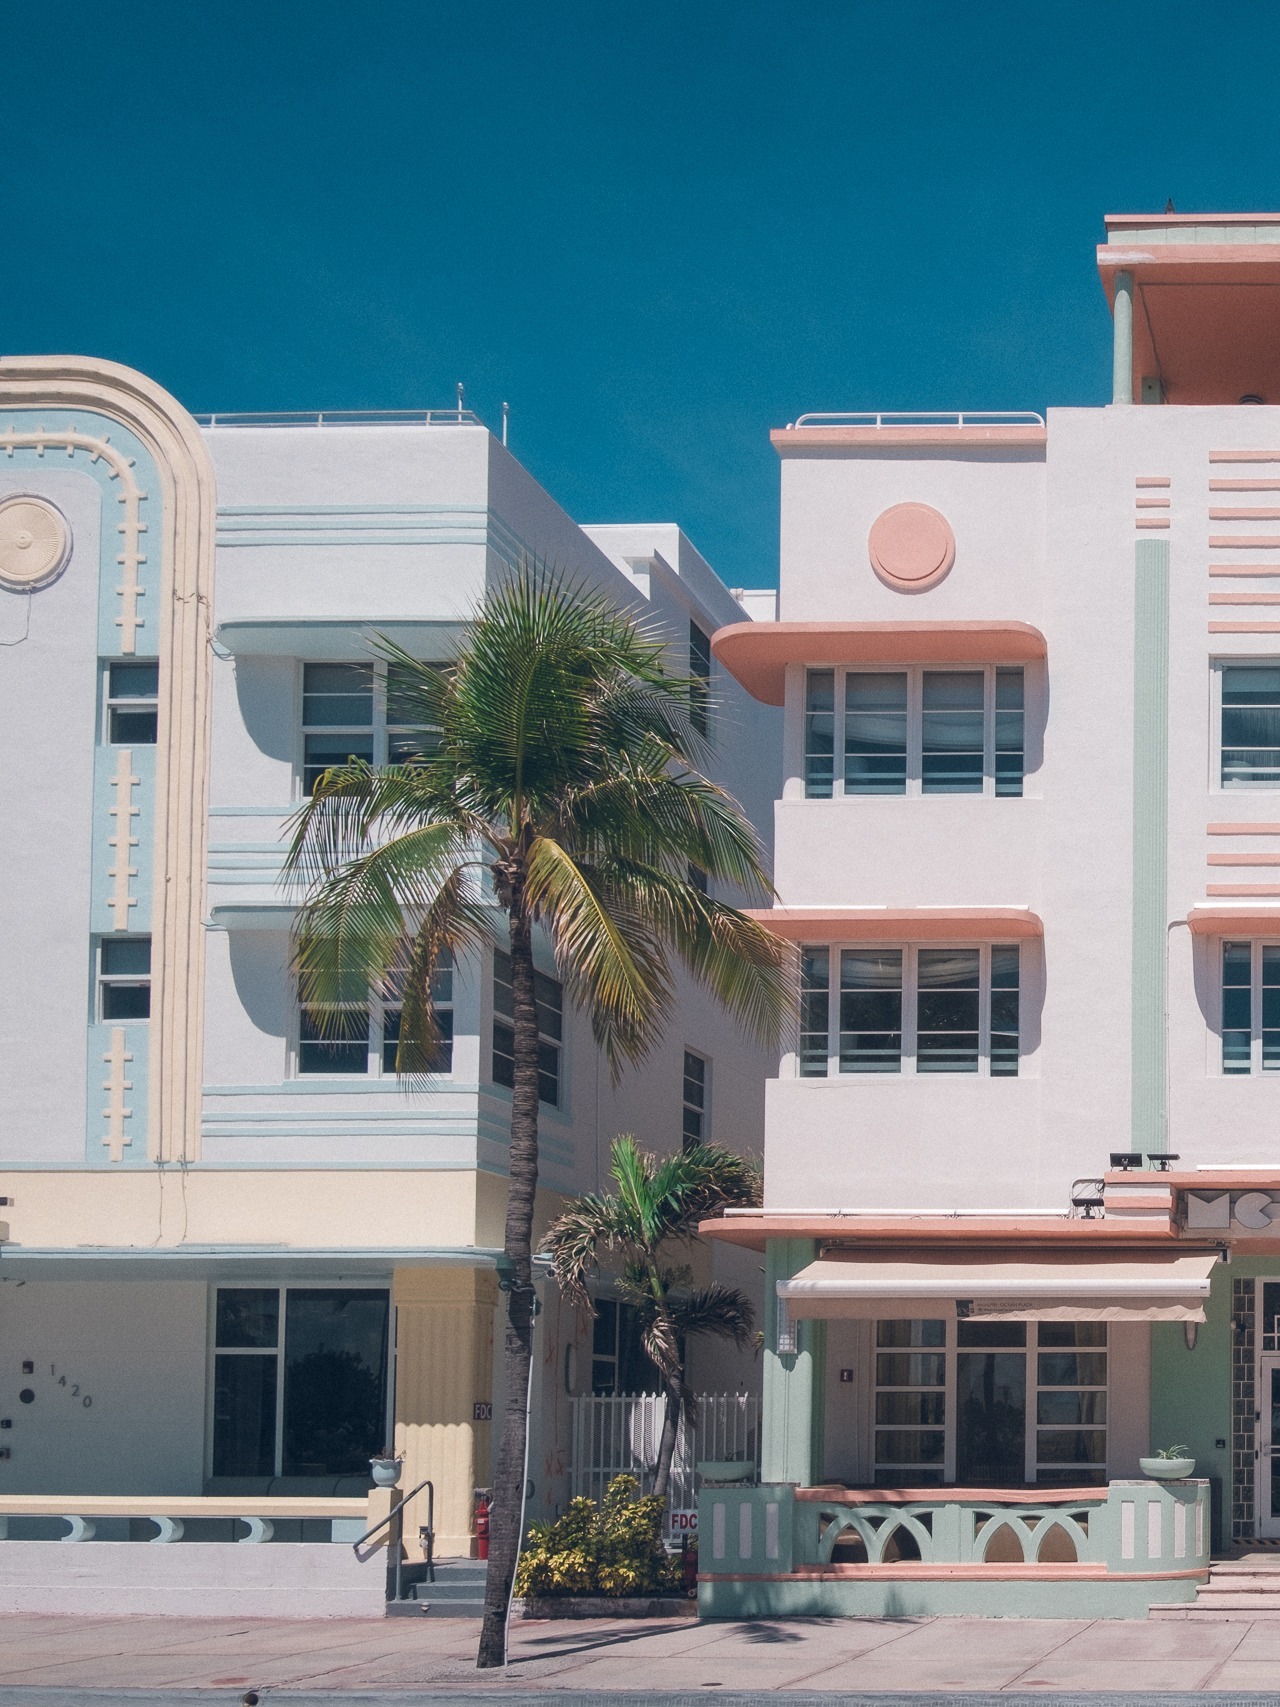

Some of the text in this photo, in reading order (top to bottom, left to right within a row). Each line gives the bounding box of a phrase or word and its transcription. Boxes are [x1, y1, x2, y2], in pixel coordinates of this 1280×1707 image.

[50, 1364, 92, 1408] 1420
[475, 1404, 491, 1419] FDC
[671, 1513, 698, 1530] FDC
